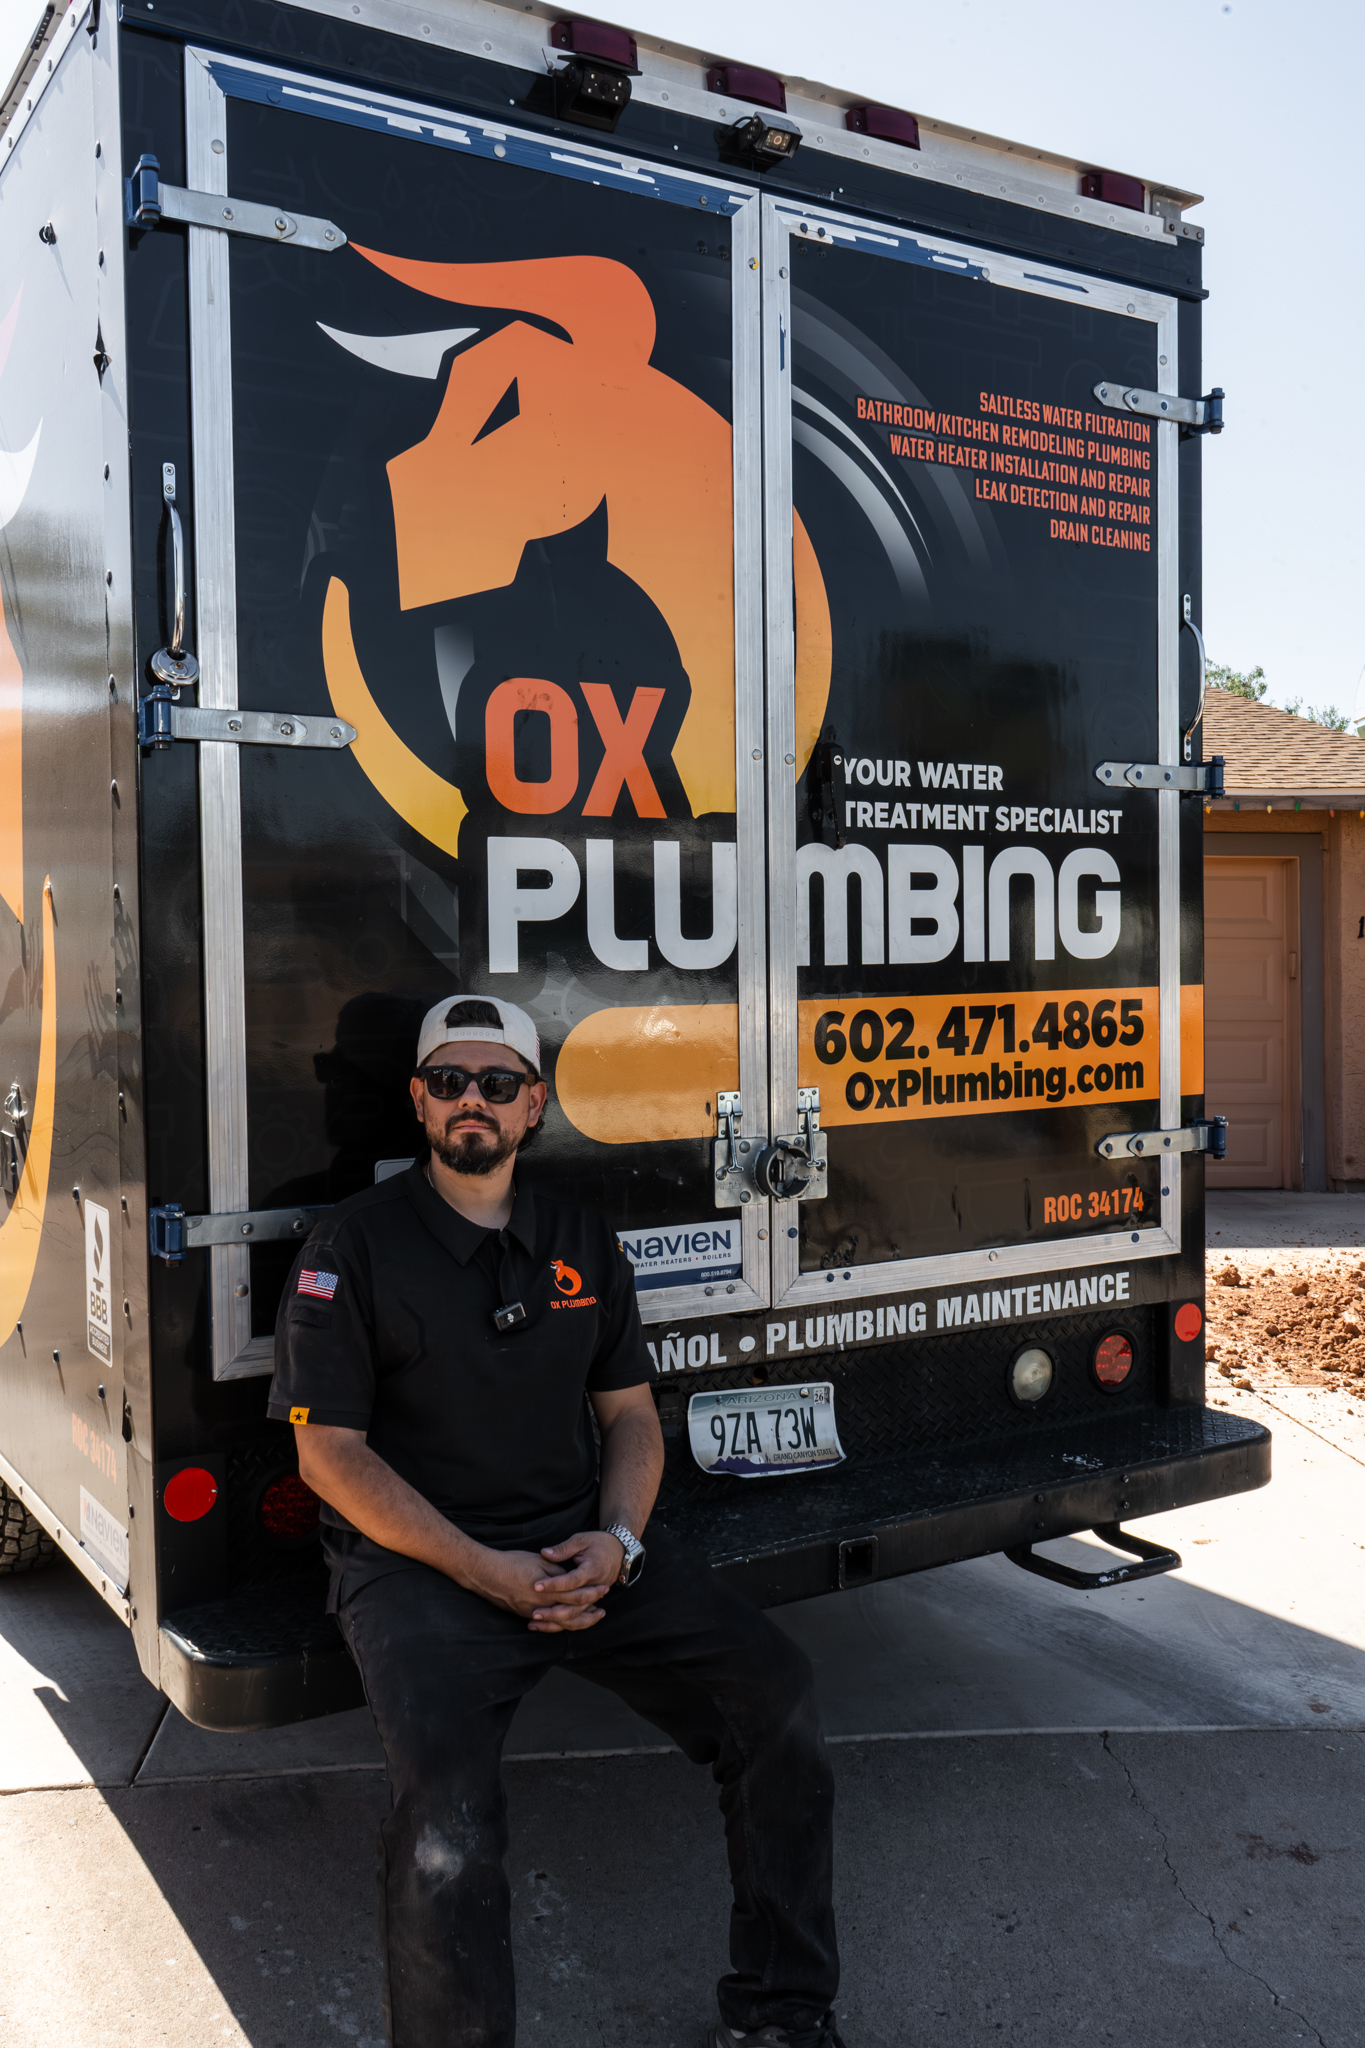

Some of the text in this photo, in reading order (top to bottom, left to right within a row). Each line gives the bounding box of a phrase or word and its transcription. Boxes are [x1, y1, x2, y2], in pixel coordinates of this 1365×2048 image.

[857, 397, 1150, 471] BATHROOM/KITCHEN REMODELING PLUMBING
[979, 392, 1150, 443] SALTLESS WATER FILTRATION
[890, 434, 1150, 498] WATER HEATER INSTALLATION AND REPAIR
[975, 478, 1150, 525] LEAK DETECTION AND REPAIR
[1050, 519, 1150, 552] DRAIN CLEANING
[485, 678, 668, 819] OX
[844, 758, 1004, 791] YOUR WATER
[845, 801, 1123, 834] TREATMENT SPECIALIST
[487, 836, 1121, 973] PLUMBING
[814, 998, 1144, 1065] 602.471.4865
[845, 1060, 1144, 1111] OxPlumbing.com
[1044, 1187, 1144, 1223] ROC 34174
[634, 1261, 658, 1269] WATER
[661, 1257, 692, 1266] HEATERS
[90, 1291, 108, 1325] BBB
[550, 1296, 597, 1309] OX PLUMBING
[766, 1302, 927, 1355] PLUMBING
[936, 1271, 1130, 1329] MAINTENANCE
[726, 1391, 798, 1406] ARIZONA
[814, 1392, 824, 1403] 26
[72, 1412, 117, 1485] ROC 34174
[710, 1407, 818, 1457] 9ZA 73W
[773, 1448, 833, 1462] GRAND CANYON STATE
